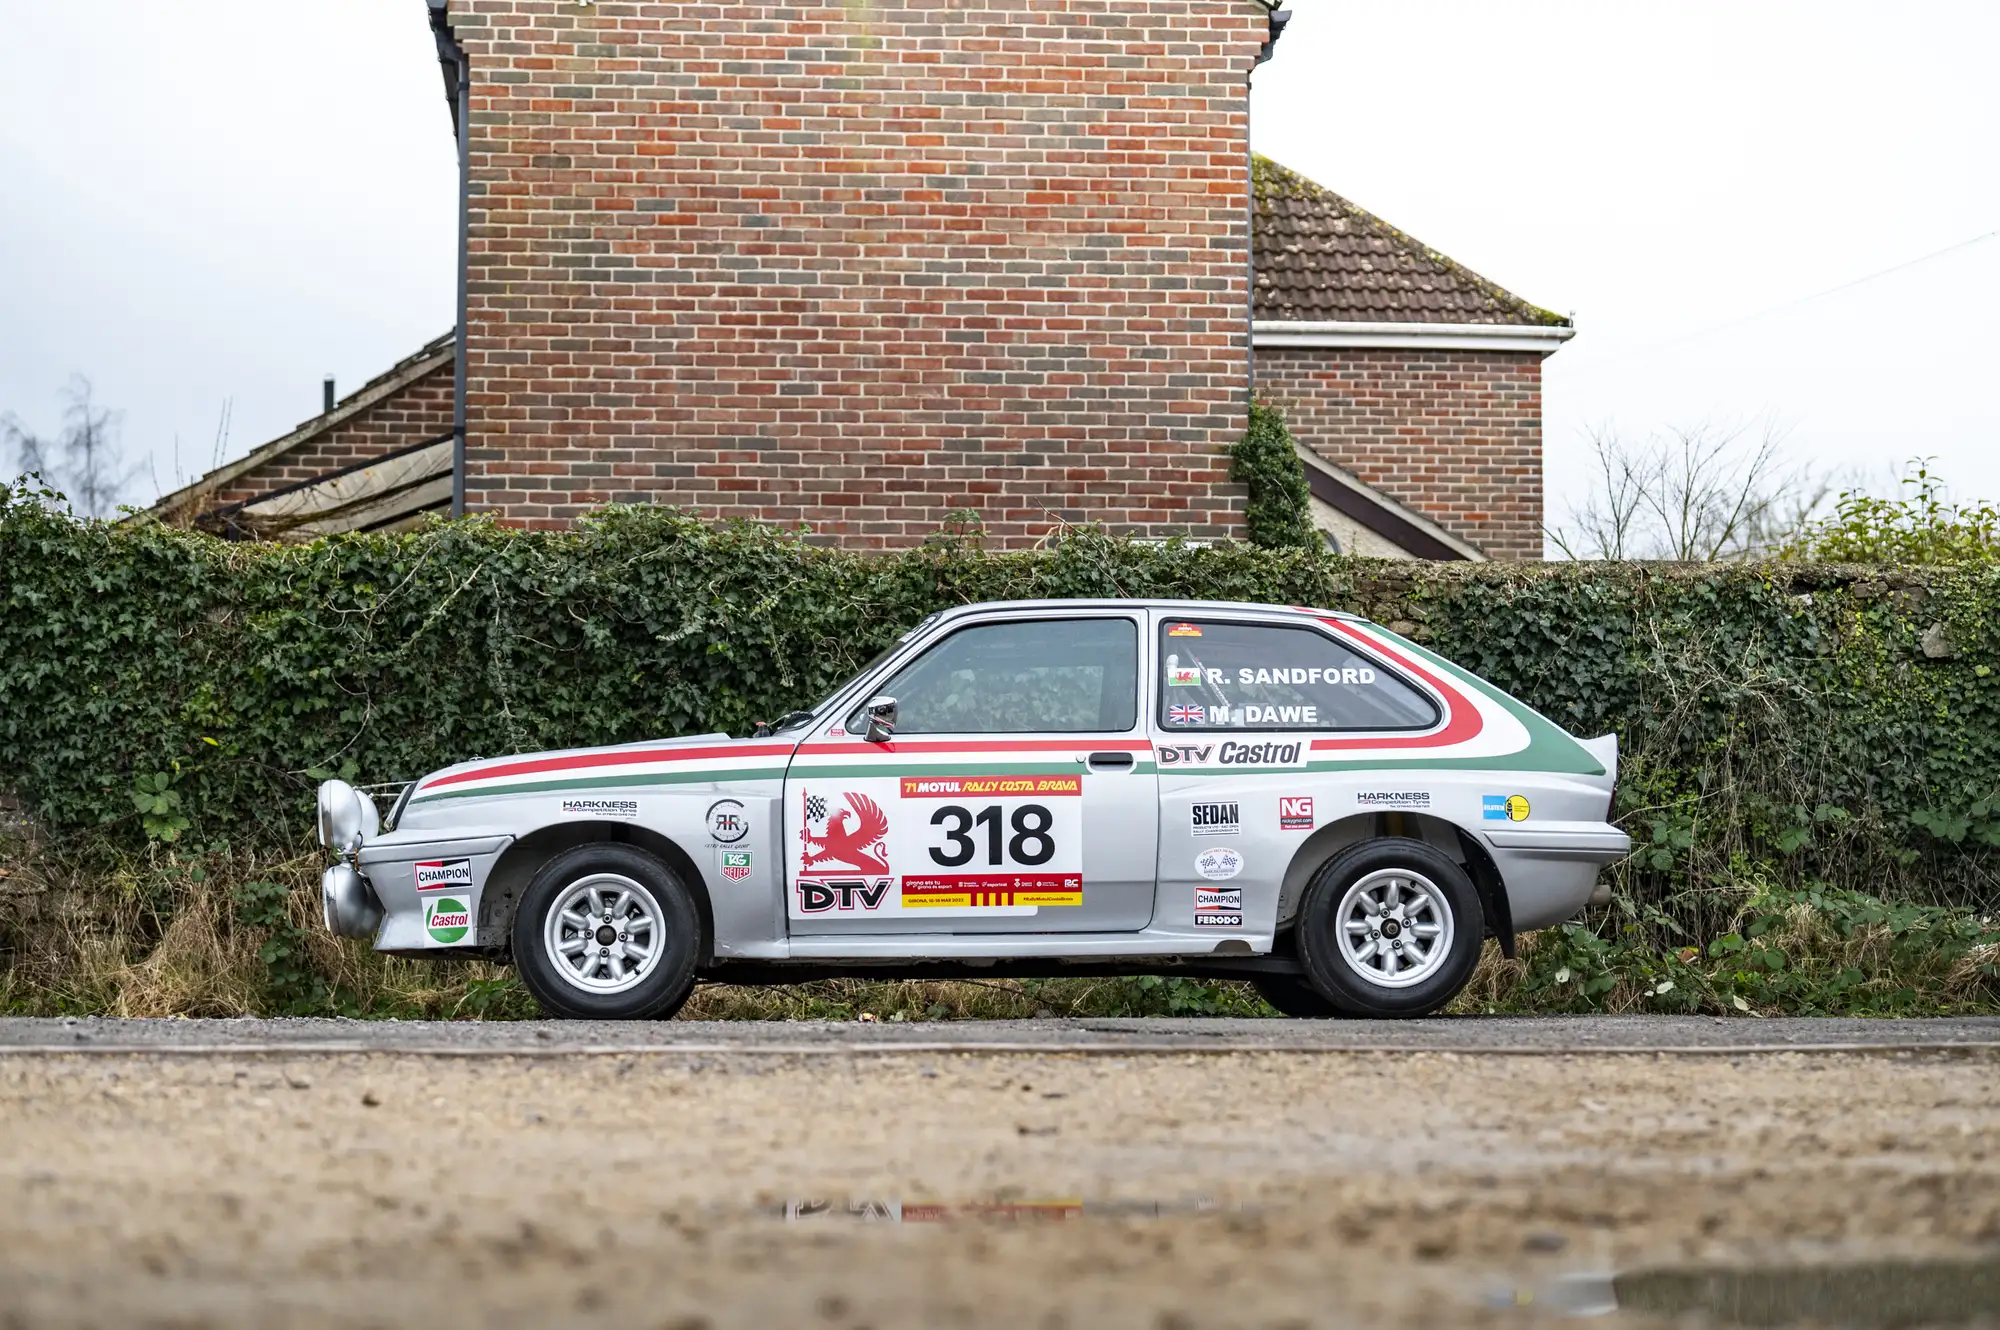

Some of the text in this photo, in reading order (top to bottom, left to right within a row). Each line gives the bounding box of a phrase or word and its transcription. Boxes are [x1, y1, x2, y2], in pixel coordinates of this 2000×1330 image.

[1207, 668, 1376, 685] R. SANDFORD
[1209, 705, 1318, 723] M. DAWE
[1157, 741, 1302, 764] DTV Castrol
[917, 781, 961, 793] MOTUL
[962, 781, 998, 792] RALLY
[1000, 780, 1034, 791] COSTA
[1037, 780, 1078, 791] BRAVA
[1357, 792, 1430, 800] HARKNESS
[563, 800, 637, 809] HARKNESS
[1281, 798, 1312, 816] NG
[1192, 804, 1239, 825] SEDAN
[928, 804, 1056, 867] 318
[727, 854, 747, 866] TAG
[418, 868, 469, 882] CHAMPION
[724, 866, 750, 880] HEUER
[905, 880, 924, 888] girona
[798, 880, 891, 911] DTV
[1198, 894, 1240, 904] CHAMPION
[431, 914, 469, 927] Castrol
[1197, 916, 1240, 924] FERODO
